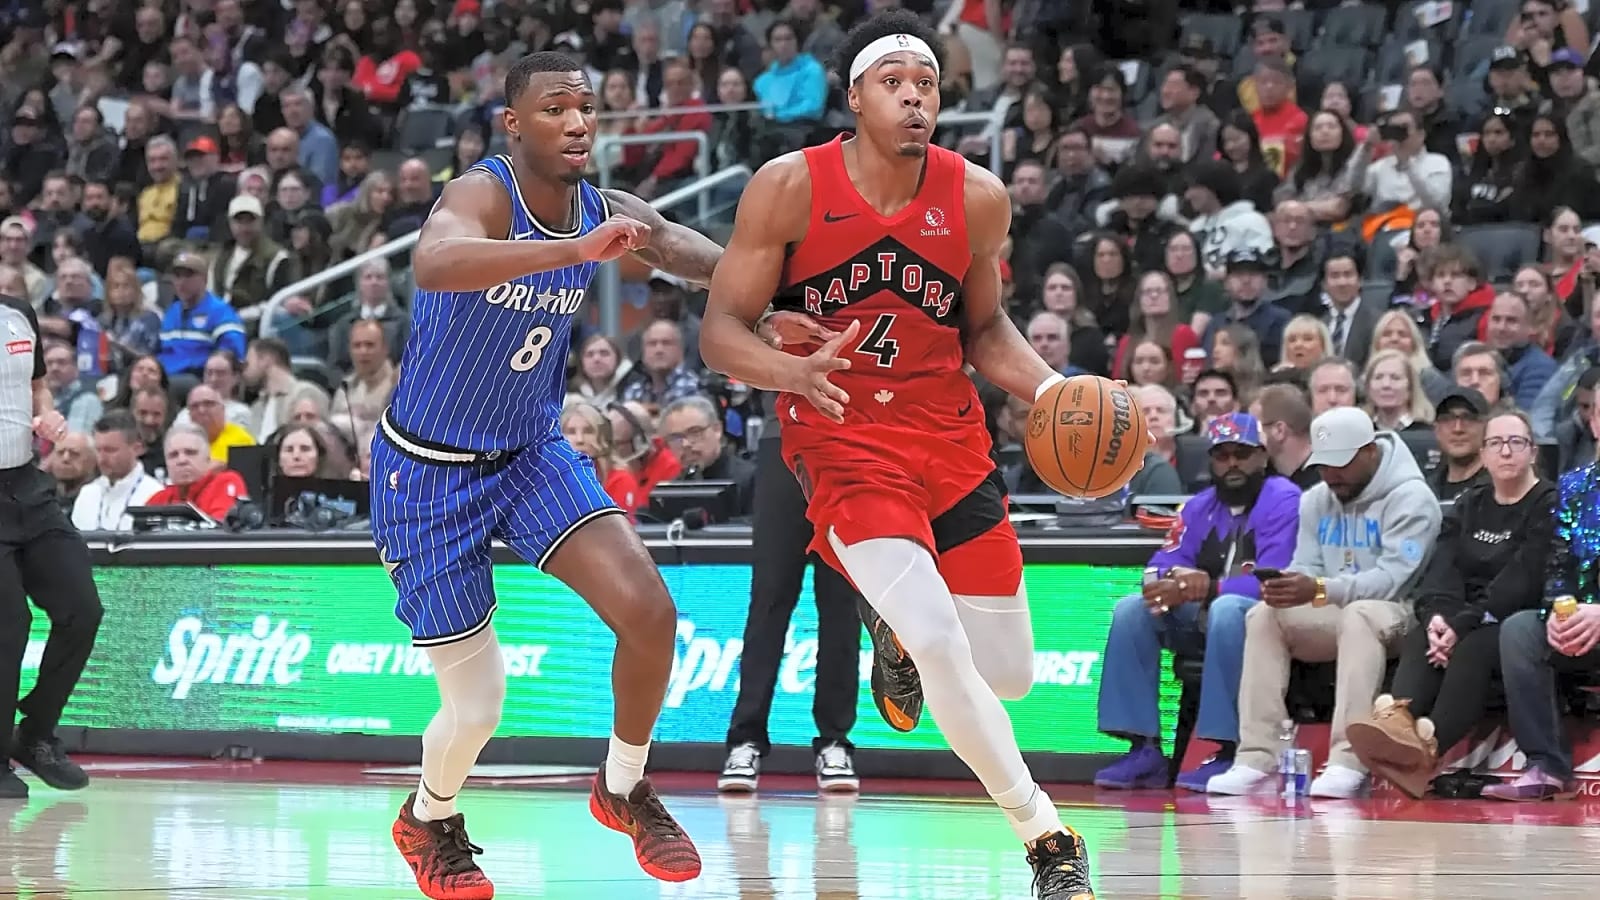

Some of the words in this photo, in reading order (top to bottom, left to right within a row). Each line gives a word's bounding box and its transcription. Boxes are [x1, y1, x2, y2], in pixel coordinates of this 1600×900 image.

[920, 228, 936, 237] Sun
[936, 227, 951, 236] Life
[805, 252, 954, 318] RAPTORS
[510, 326, 552, 372] 8
[854, 313, 900, 369] 4
[1103, 389, 1131, 466] Wilson
[152, 615, 311, 700] Sprite
